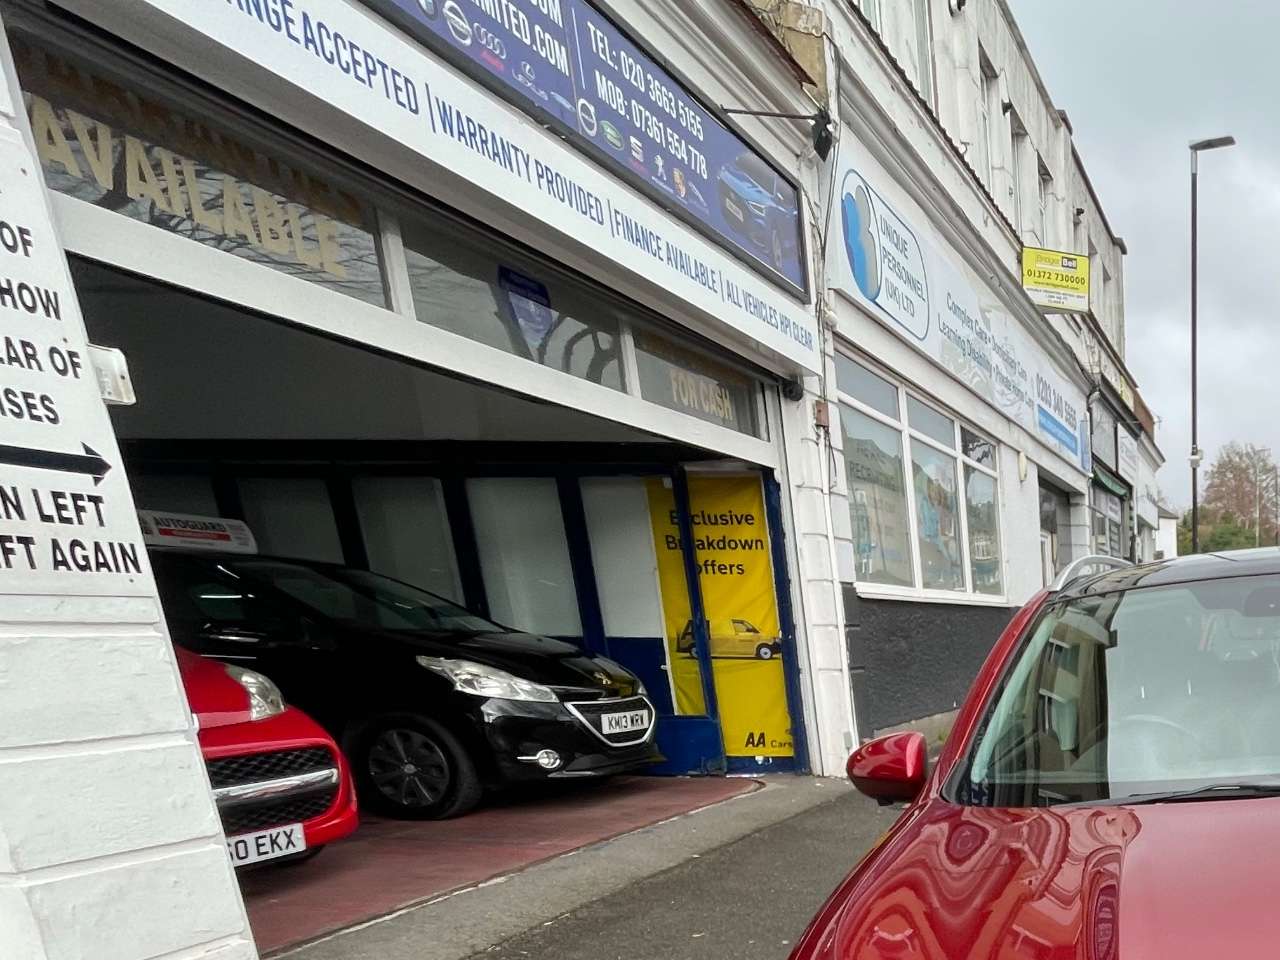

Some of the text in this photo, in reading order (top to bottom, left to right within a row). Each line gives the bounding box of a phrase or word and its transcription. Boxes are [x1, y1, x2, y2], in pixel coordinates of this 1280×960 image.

[587, 21, 704, 142] TEL: 020 3663 5155
[594, 69, 630, 121] MOB:
[631, 99, 665, 149] 07361
[667, 128, 688, 166] 554
[688, 145, 708, 180] 778
[31, 93, 347, 280] AVAILABLE
[302, 11, 419, 115] ACCEPTED
[435, 95, 532, 184] WARRANTY
[534, 159, 604, 226] PROVIDED
[614, 208, 664, 262] FINANCE
[666, 240, 718, 295] AVAILABLE
[726, 279, 742, 308] ALL
[742, 289, 779, 330] VEHICLES
[779, 311, 793, 339] HPI
[793, 321, 814, 352] CLEAR
[0, 220, 33, 258] OF
[880, 214, 909, 260] UNIQUE
[882, 246, 926, 303] PERSONNEL
[1027, 269, 1086, 285] 01372 730000
[947, 292, 973, 332] Complex
[938, 312, 967, 357] Learning
[0, 336, 83, 379] AR OF
[31, 488, 105, 527] LEFT
[670, 510, 755, 526] Eclusive
[0, 535, 142, 574] FT AGAIN
[608, 714, 628, 730] KM13
[745, 732, 792, 748] AA Cars
[227, 829, 296, 861] 0 EKX
